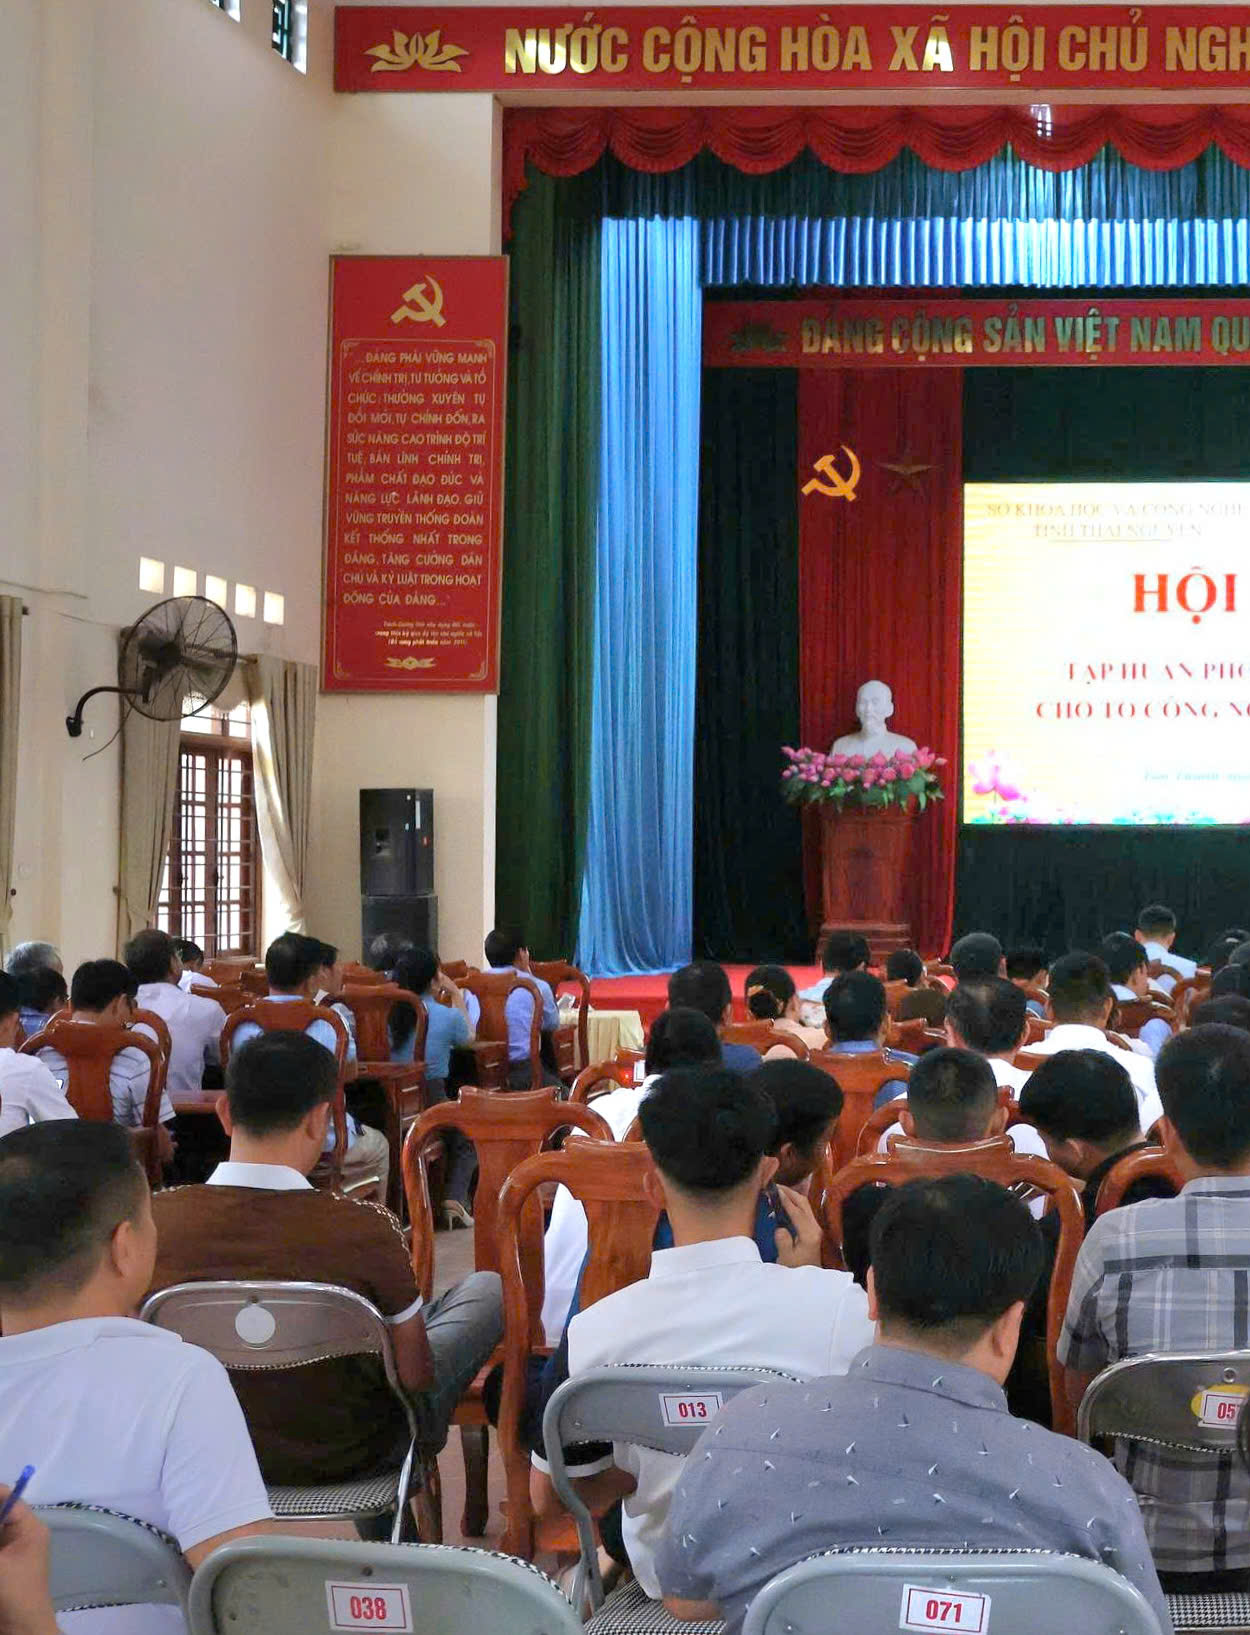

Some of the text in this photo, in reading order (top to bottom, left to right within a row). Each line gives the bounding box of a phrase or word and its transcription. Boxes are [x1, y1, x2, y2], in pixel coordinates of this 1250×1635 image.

[504, 12, 629, 75] NƯỚC
[642, 15, 767, 83] CỘNG
[780, 13, 872, 72] HÒA
[887, 14, 954, 72] XÃ
[969, 14, 1044, 82] HỘI
[1058, 8, 1149, 71] CHỦ
[801, 304, 884, 354] ĐẢNG
[891, 308, 974, 361] CỘNG
[983, 304, 1046, 353] SẢN
[1054, 307, 1120, 361] VIỆT
[1130, 316, 1201, 353] NAM
[472, 413, 485, 424] RA
[402, 434, 424, 444] CAO
[448, 535, 482, 544] TRONG
[421, 574, 453, 585] TRONG
[1133, 566, 1237, 624] HỘI
[678, 1401, 707, 1418] 013
[1217, 1402, 1240, 1419] 05
[350, 1595, 387, 1620] 038
[925, 1599, 963, 1623] 071
